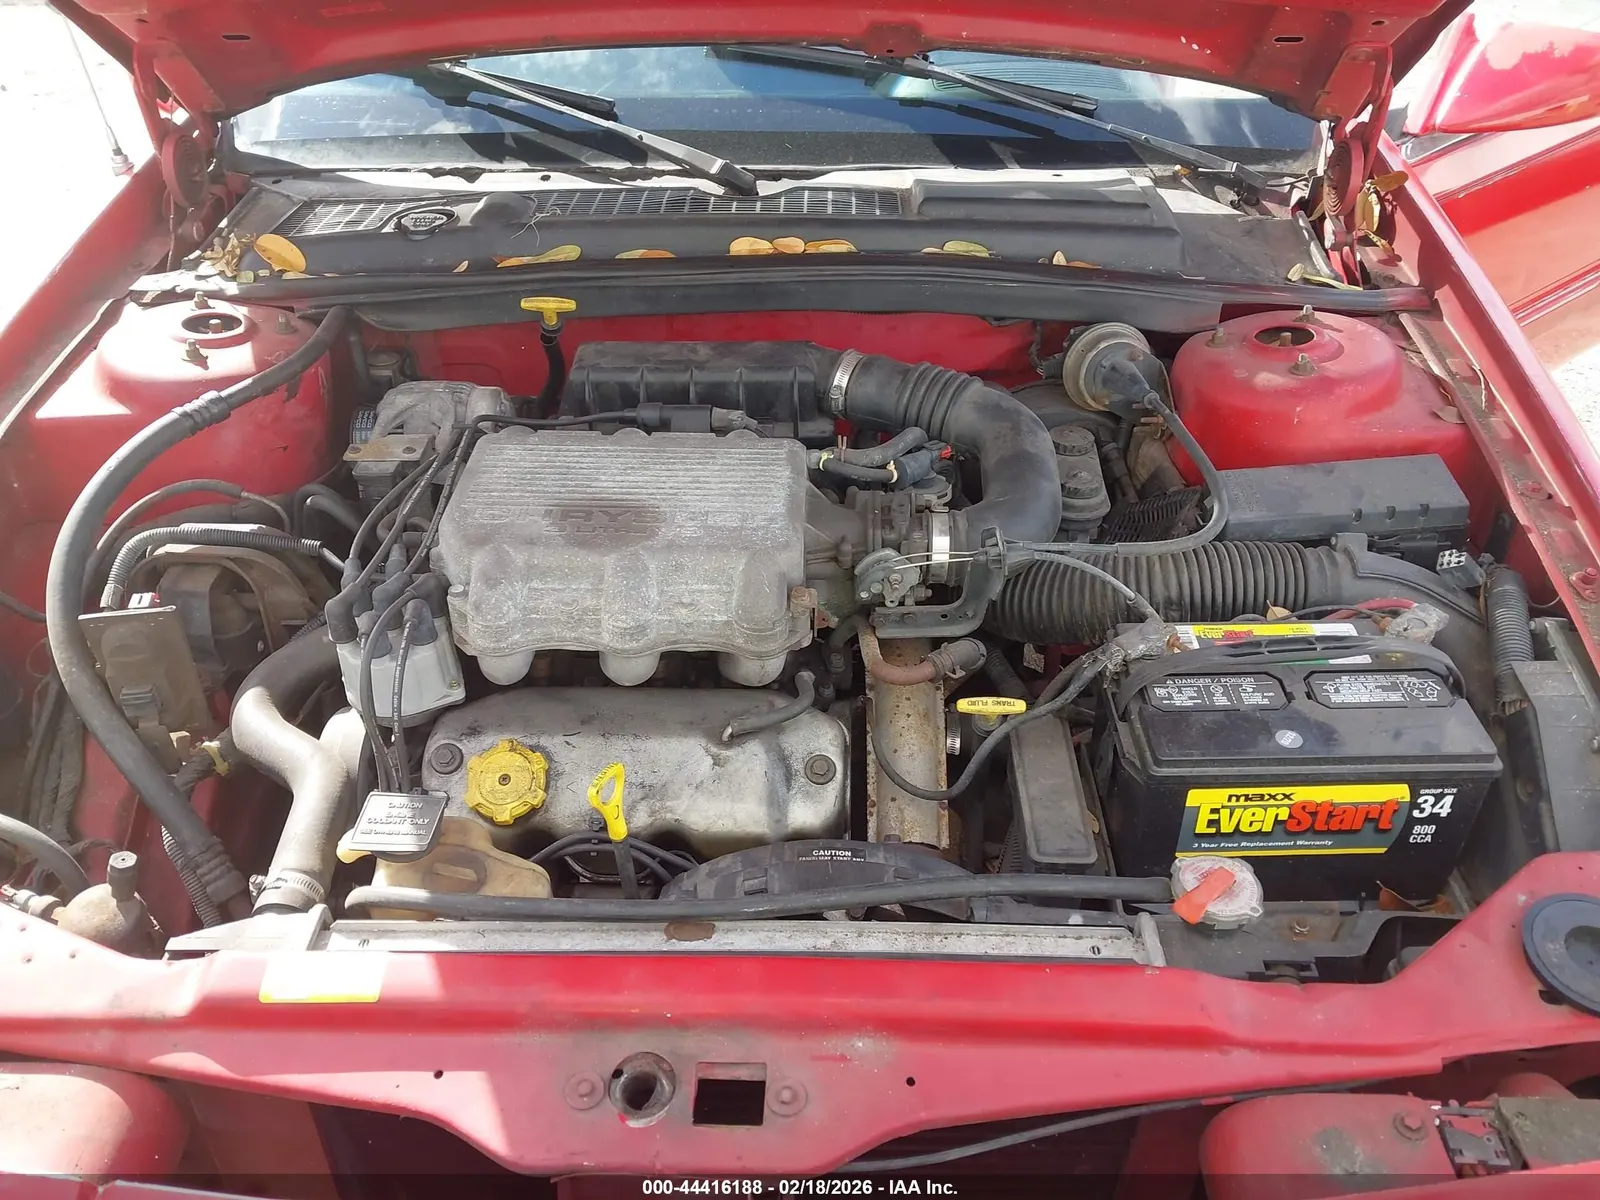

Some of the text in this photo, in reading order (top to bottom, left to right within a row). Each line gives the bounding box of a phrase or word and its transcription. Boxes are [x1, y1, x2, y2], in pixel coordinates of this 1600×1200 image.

[1199, 629, 1255, 639] EverStart
[1227, 793, 1296, 803] maxx
[1412, 795, 1454, 818] 34
[1195, 798, 1400, 834] EverStart
[1412, 825, 1436, 834] 800
[1409, 835, 1432, 843] CCA
